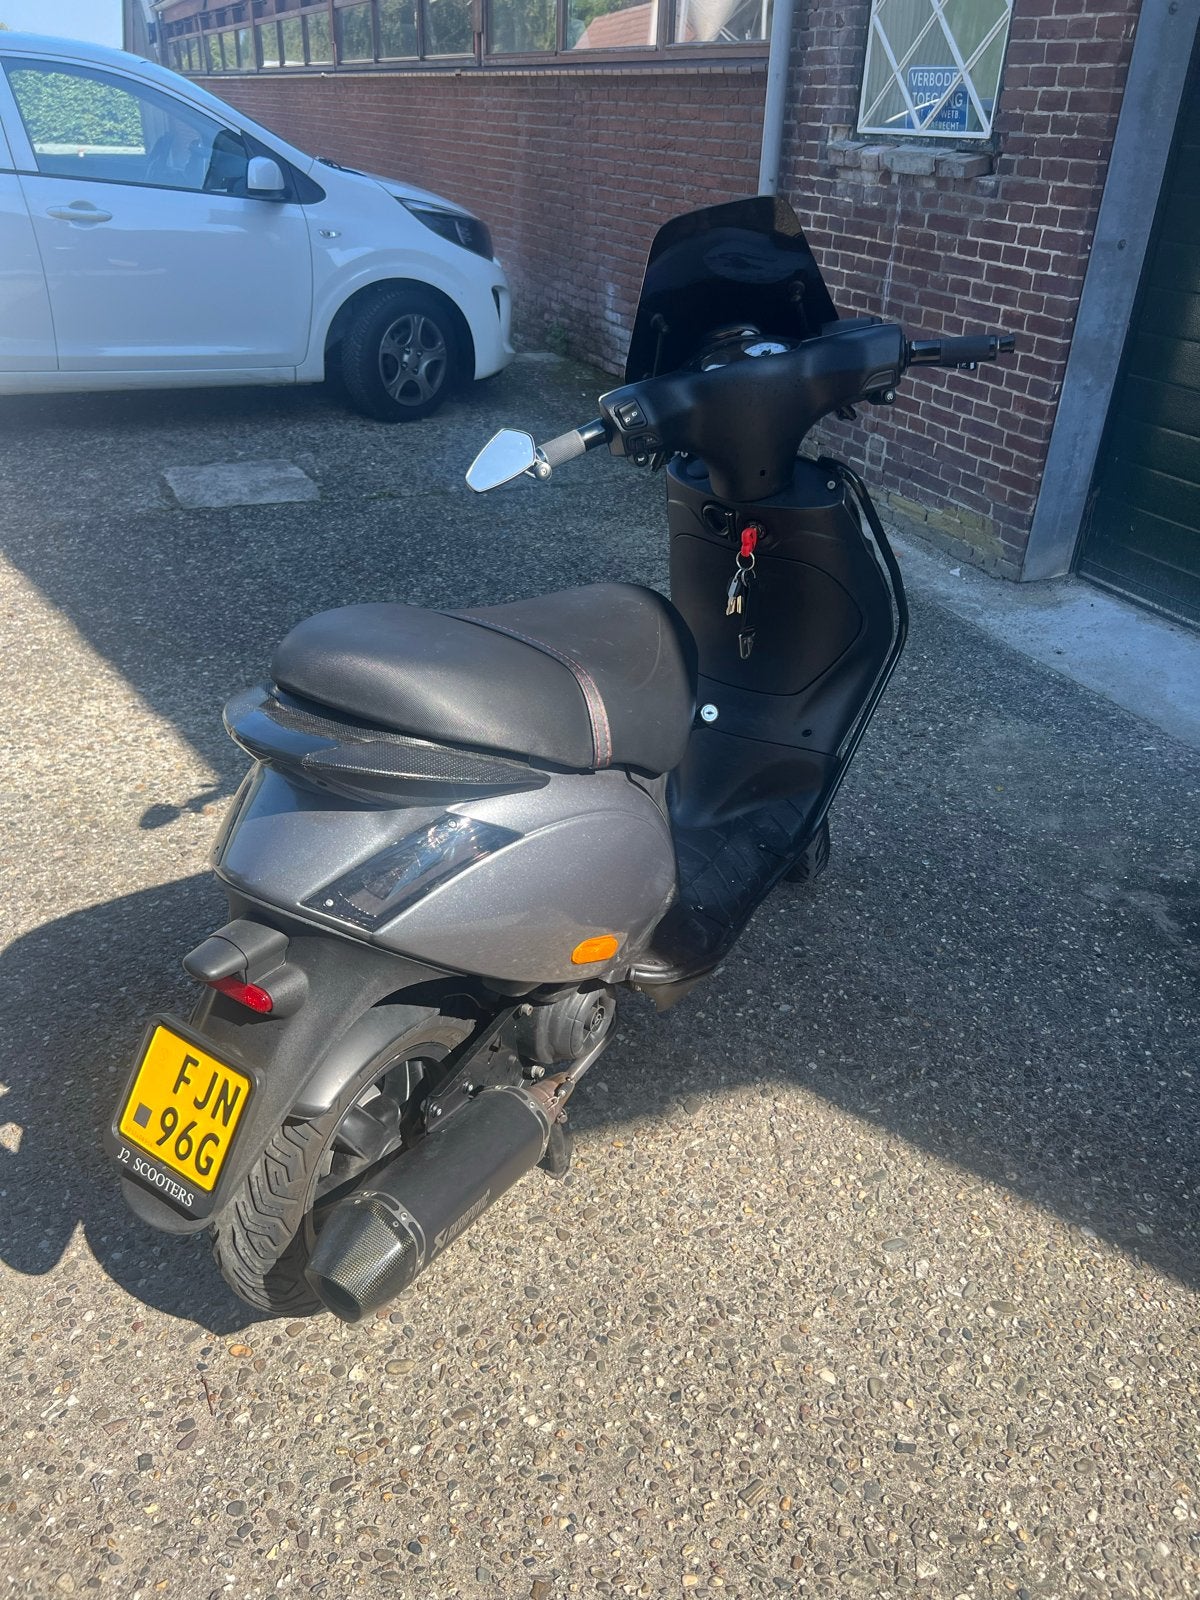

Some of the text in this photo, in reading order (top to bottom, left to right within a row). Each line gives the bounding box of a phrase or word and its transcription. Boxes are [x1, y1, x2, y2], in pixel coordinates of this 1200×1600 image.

[172, 1054, 241, 1128] FJN
[156, 1106, 220, 1176] 96G
[117, 1146, 195, 1207] J2 SCOOTERS
